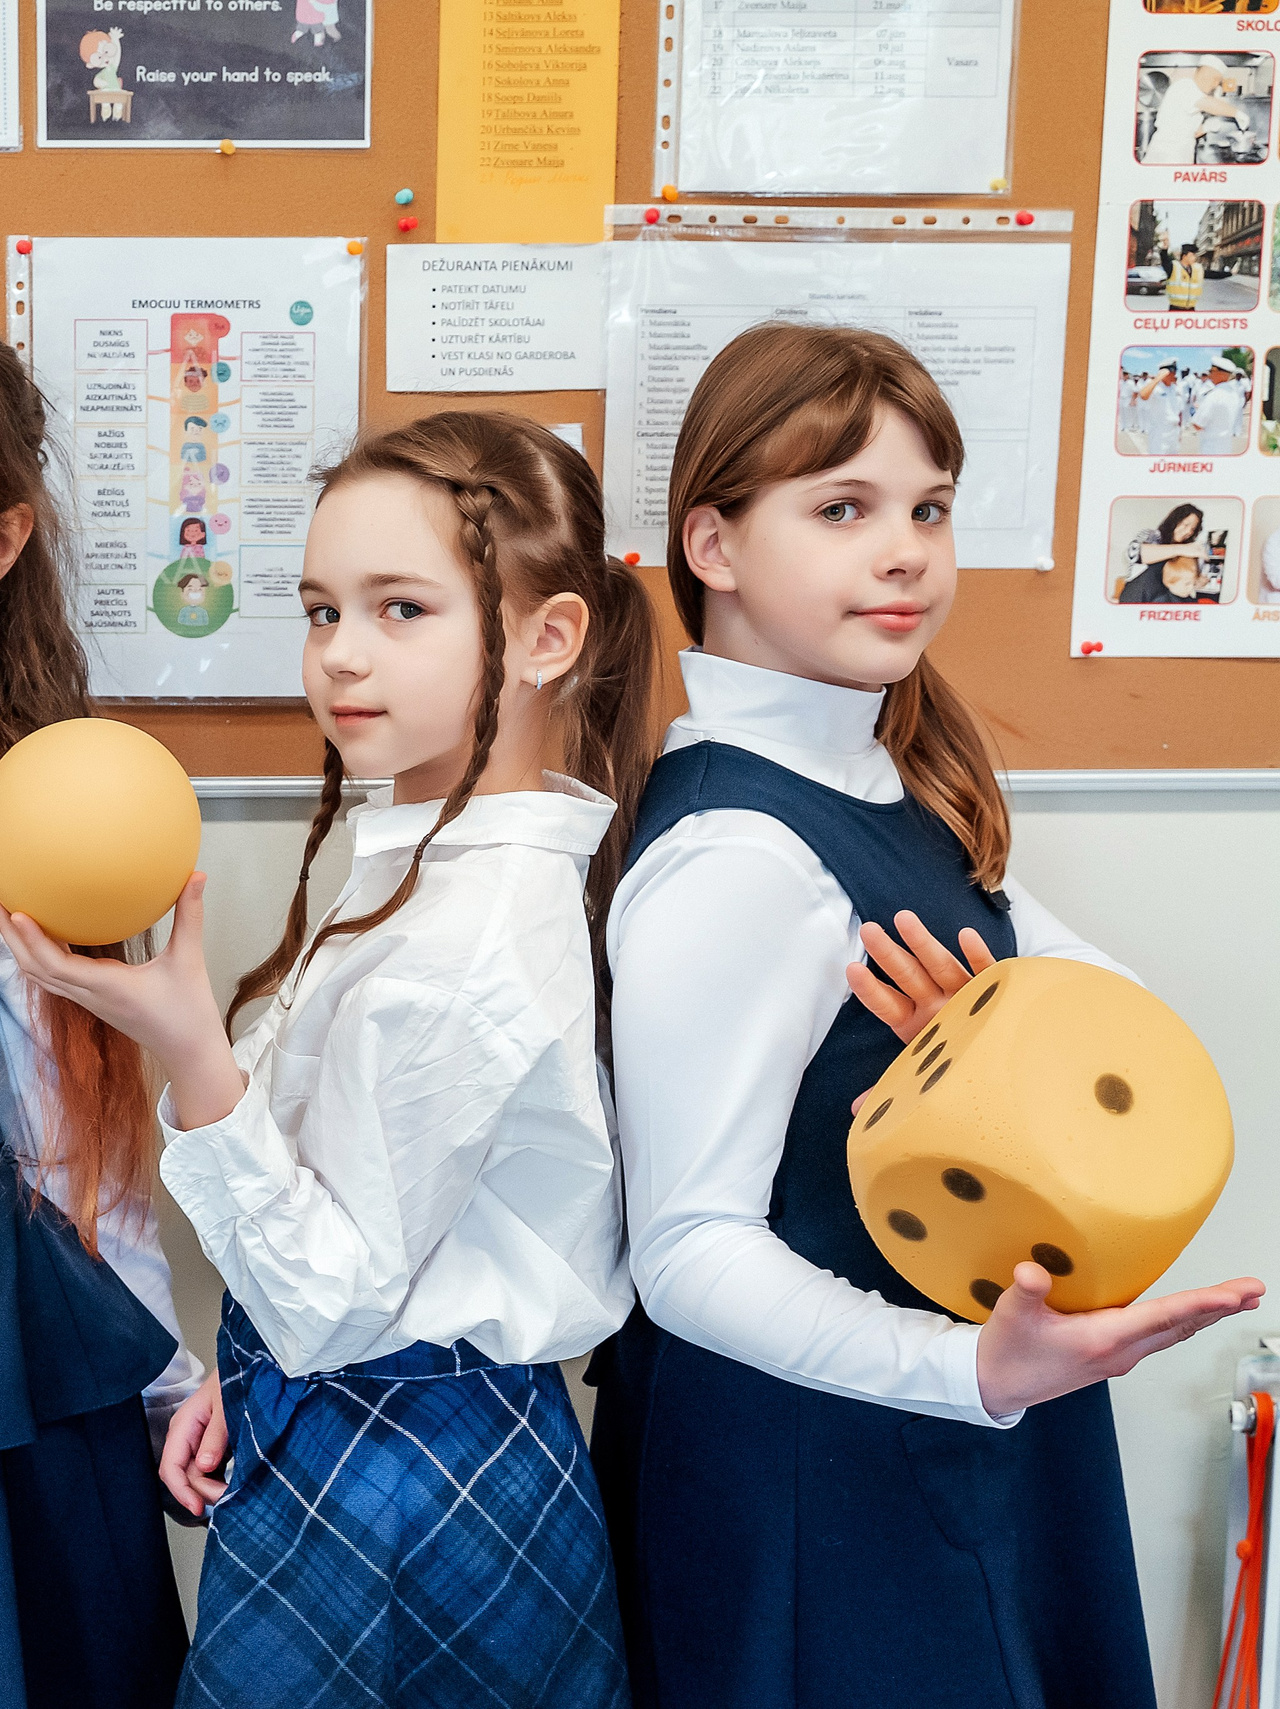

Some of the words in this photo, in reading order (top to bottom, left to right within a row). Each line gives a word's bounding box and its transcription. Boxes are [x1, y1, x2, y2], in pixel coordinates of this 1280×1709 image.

[93, 0, 114, 11] Be
[118, 0, 201, 14] respectful
[206, 0, 224, 11] to
[227, 0, 282, 11] others.
[136, 65, 176, 83] Raise
[181, 70, 218, 86] your
[221, 65, 259, 83] hand
[263, 67, 281, 83] to
[286, 65, 334, 86] speak.
[1174, 169, 1227, 183] PAVĀRS
[422, 258, 498, 272] DEŽURANTA
[501, 258, 573, 272] PIENĀKUMI
[441, 285, 479, 294] PATEIKT
[482, 285, 526, 294] DATUMU
[131, 299, 181, 309] EMOCIJU
[184, 299, 261, 309] TERMOMETRS
[441, 300, 481, 311] NOTĪRĪT
[483, 300, 514, 311] TĀFELI
[440, 317, 485, 327] PALĪDZĒT
[488, 317, 545, 327] SKOLOTĀJAI
[1133, 318, 1170, 332] CEĻU
[1174, 318, 1248, 330] POLICISTS
[440, 333, 485, 344] UZTURĒT
[489, 333, 531, 344] KĀRTĪBU
[440, 351, 464, 360] VEST
[467, 351, 494, 360] KLASI
[497, 351, 512, 360] NO
[514, 351, 576, 360] GARDEROBA
[440, 366, 455, 376] UN
[459, 366, 514, 376] PUSDIENĀS
[1149, 459, 1213, 473] JŪRNIEKI
[1139, 610, 1201, 622] FRIZIERE
